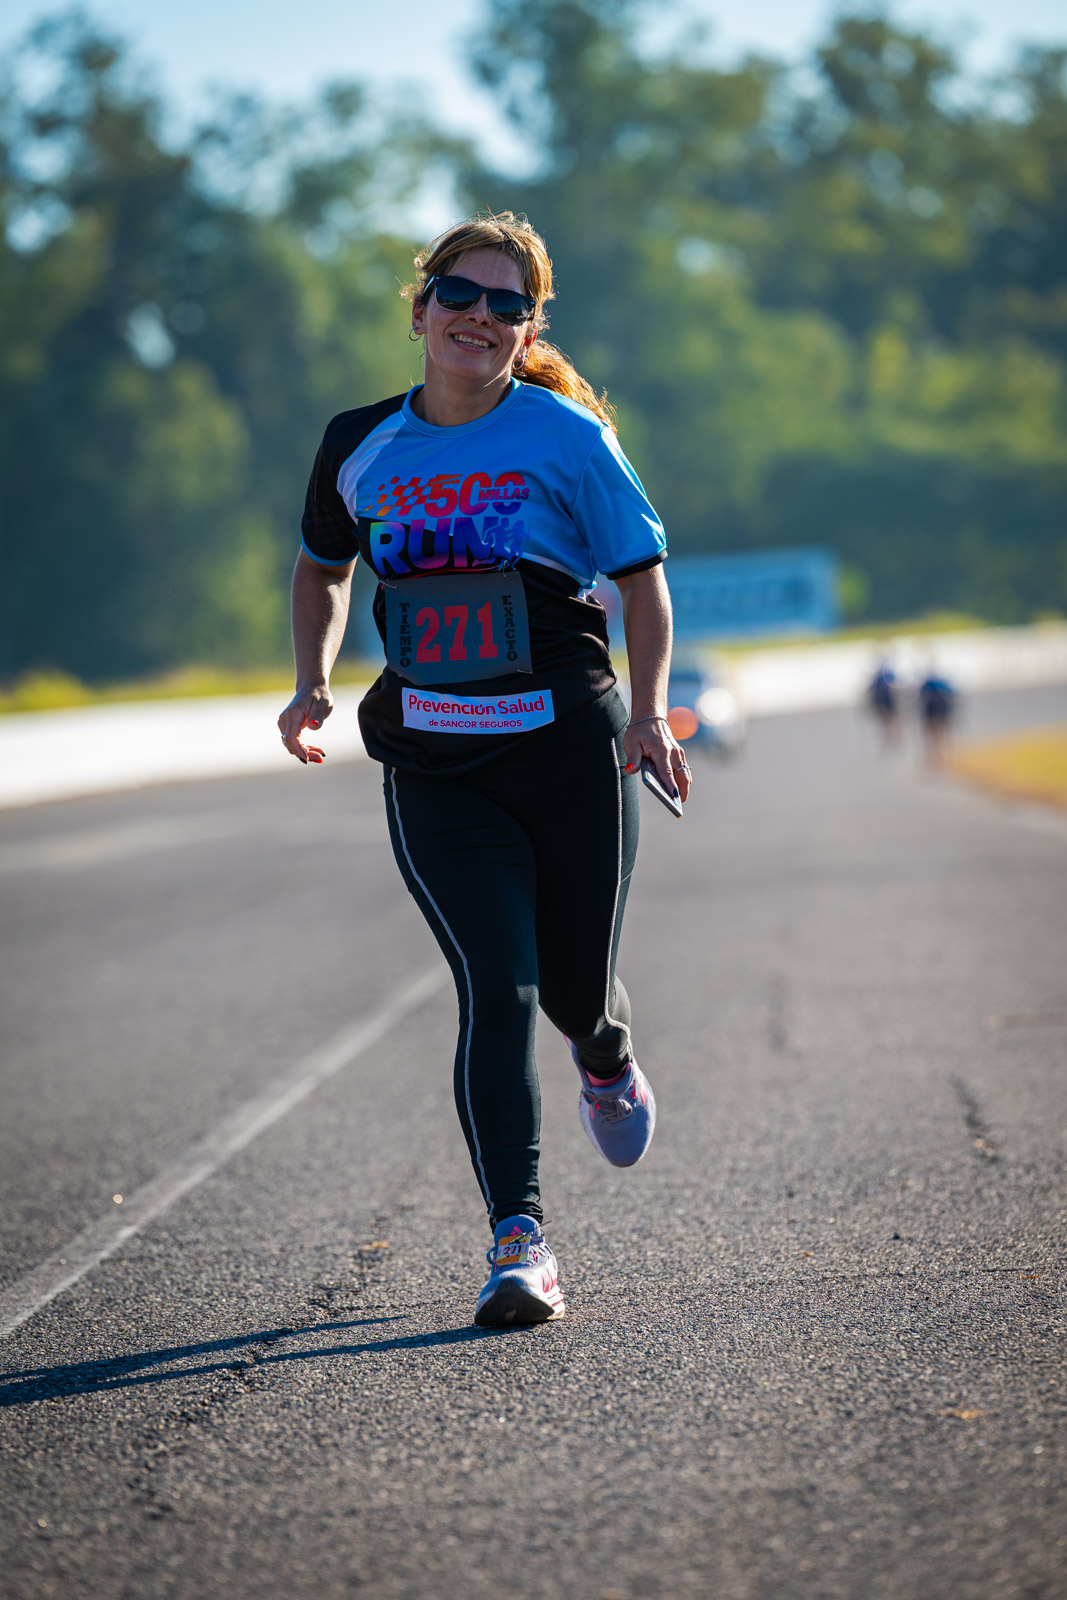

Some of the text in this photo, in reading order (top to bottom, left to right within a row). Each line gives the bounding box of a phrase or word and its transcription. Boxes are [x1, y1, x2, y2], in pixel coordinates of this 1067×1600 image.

[424, 472, 526, 517] 500
[478, 487, 530, 501] MILLAS
[399, 602, 411, 667] TIEMPO
[415, 601, 498, 663] 271
[502, 595, 518, 661] EXACTO
[408, 694, 545, 715] Prevención Salud
[428, 719, 523, 728] de SANCOR SEGUROS
[504, 1245, 522, 1255] 271
